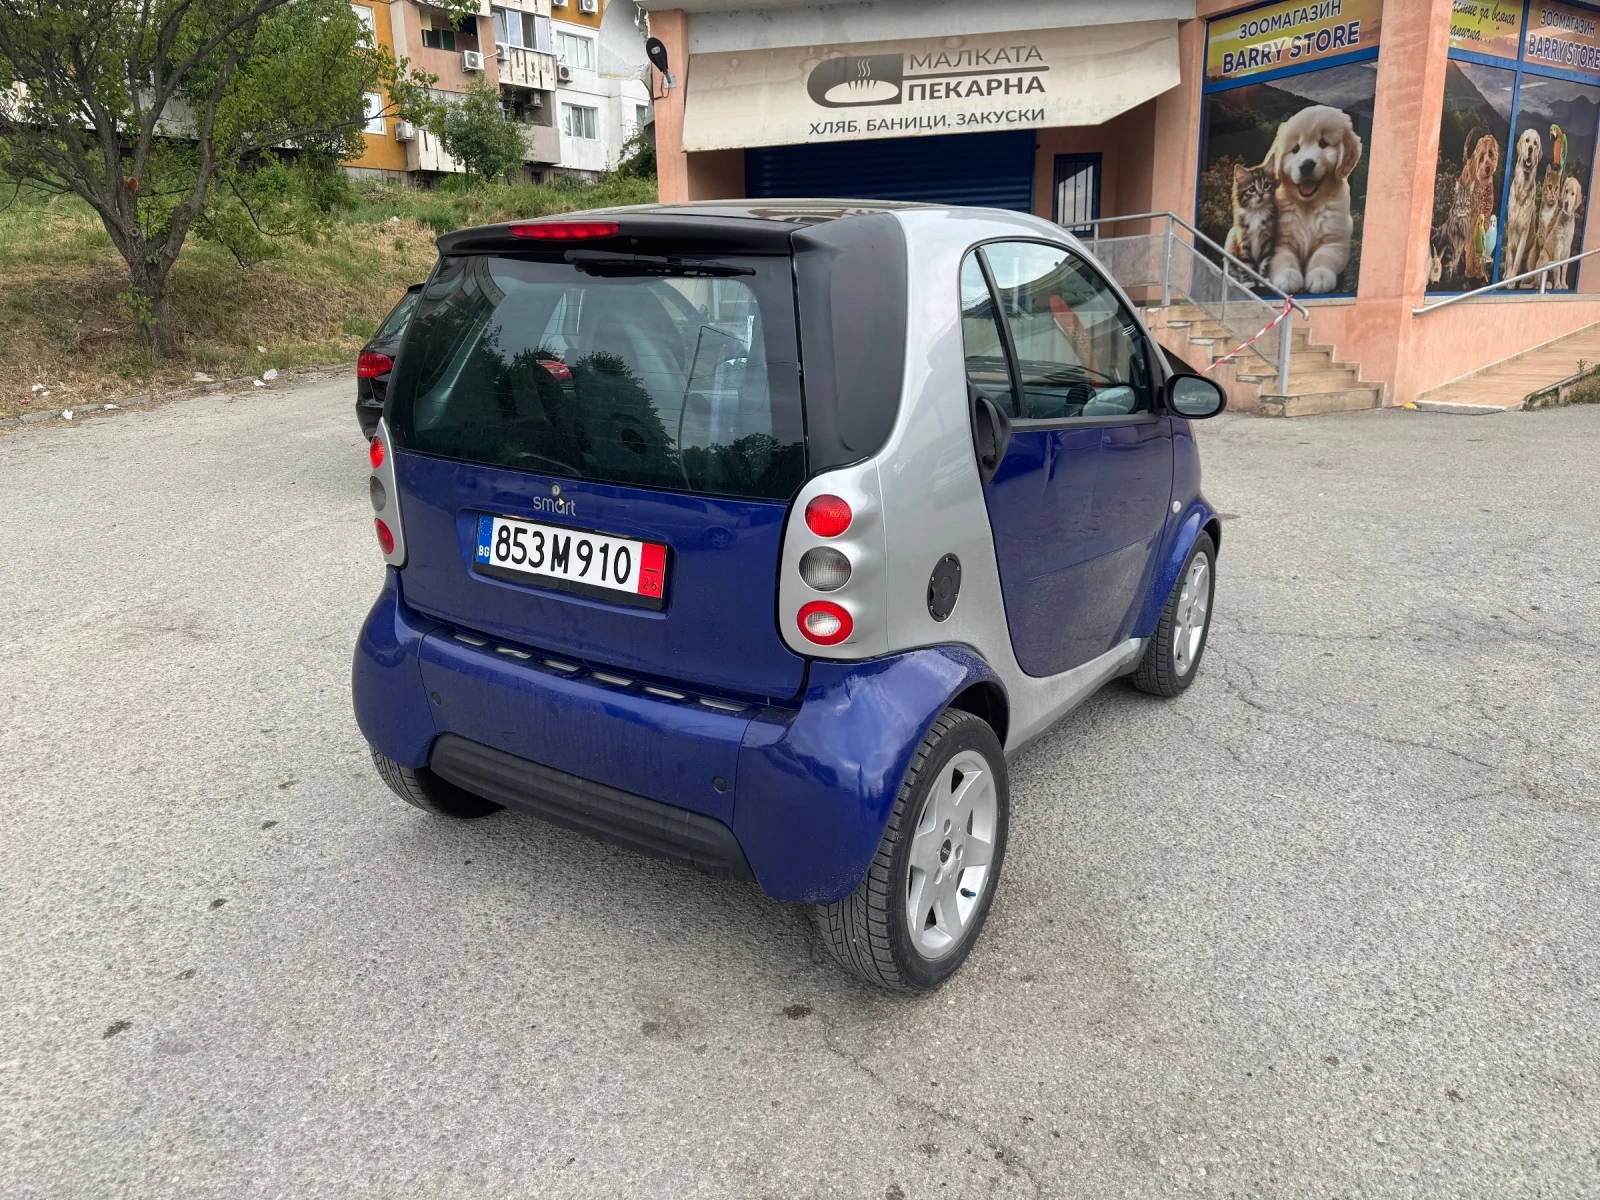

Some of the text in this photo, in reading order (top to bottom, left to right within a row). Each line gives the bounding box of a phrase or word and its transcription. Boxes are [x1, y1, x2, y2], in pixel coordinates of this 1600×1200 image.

[1239, 0, 1342, 40] ЗООМАГАЗИН
[1540, 9, 1596, 38] ЗООМАГАЗИН
[909, 45, 1044, 71] МАЛКАТА
[1222, 21, 1361, 75] BARRY STORE
[1528, 32, 1600, 70] BARRY STORE
[908, 75, 1046, 101] ПЕКАРНА
[808, 108, 1045, 135] ХЛЯБ, БАНИЦИ, ЗАКУСКИ
[533, 496, 576, 517] smart
[478, 545, 490, 558] BG
[643, 577, 658, 591] 26
